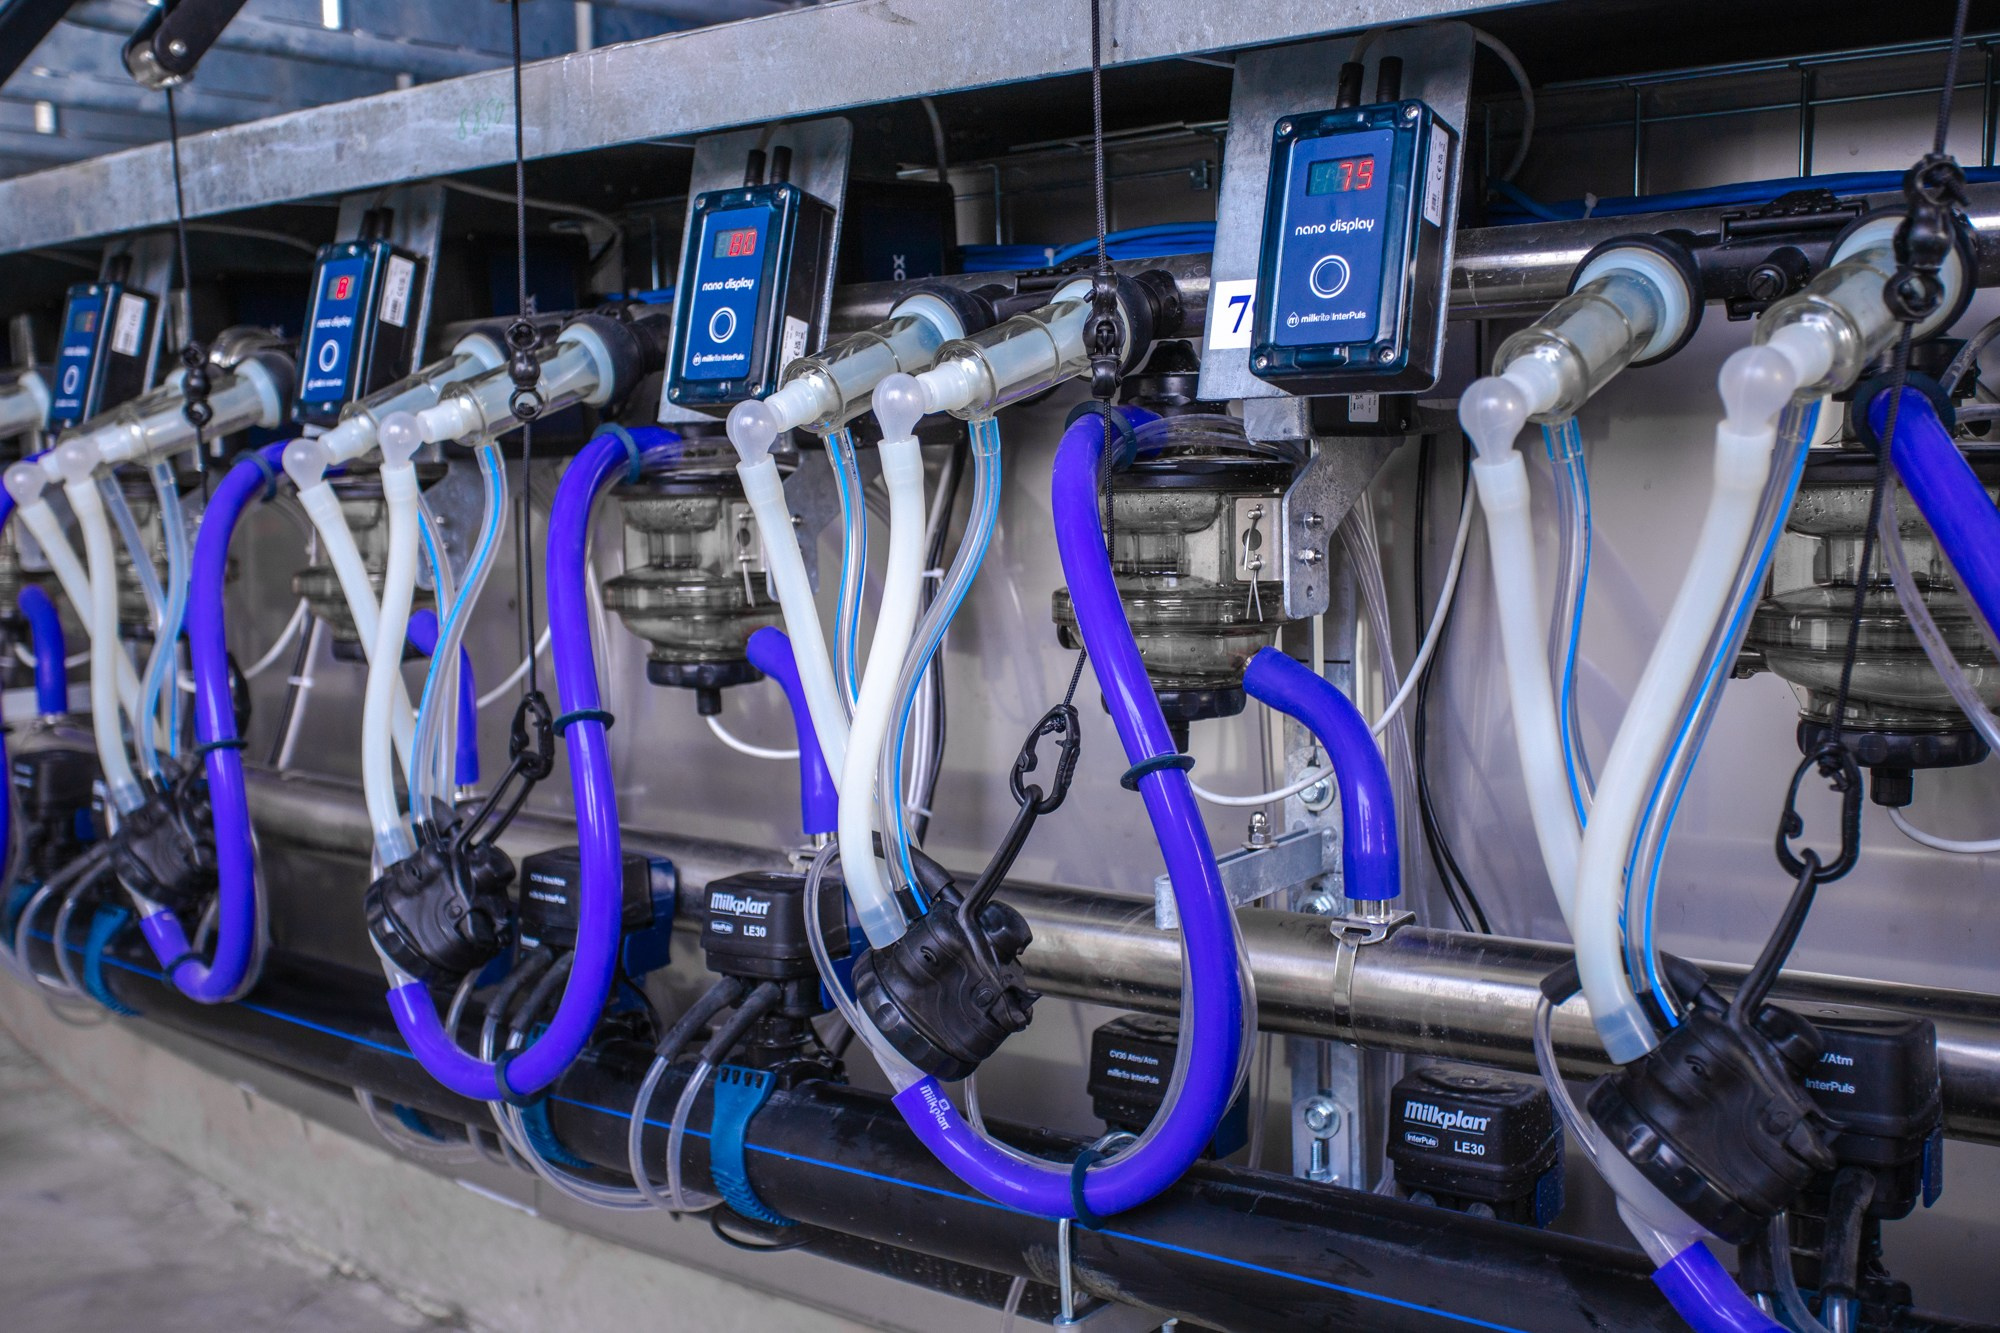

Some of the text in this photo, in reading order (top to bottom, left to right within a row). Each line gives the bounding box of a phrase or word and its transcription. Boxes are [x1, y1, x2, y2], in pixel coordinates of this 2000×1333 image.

[1295, 217, 1375, 236] nano display
[702, 277, 754, 292] nano display
[1332, 310, 1367, 320] InterPuls
[743, 925, 766, 938] LE30
[1805, 1078, 1856, 1094] InterPuls
[1407, 1133, 1485, 1156] InterPuls LE30
